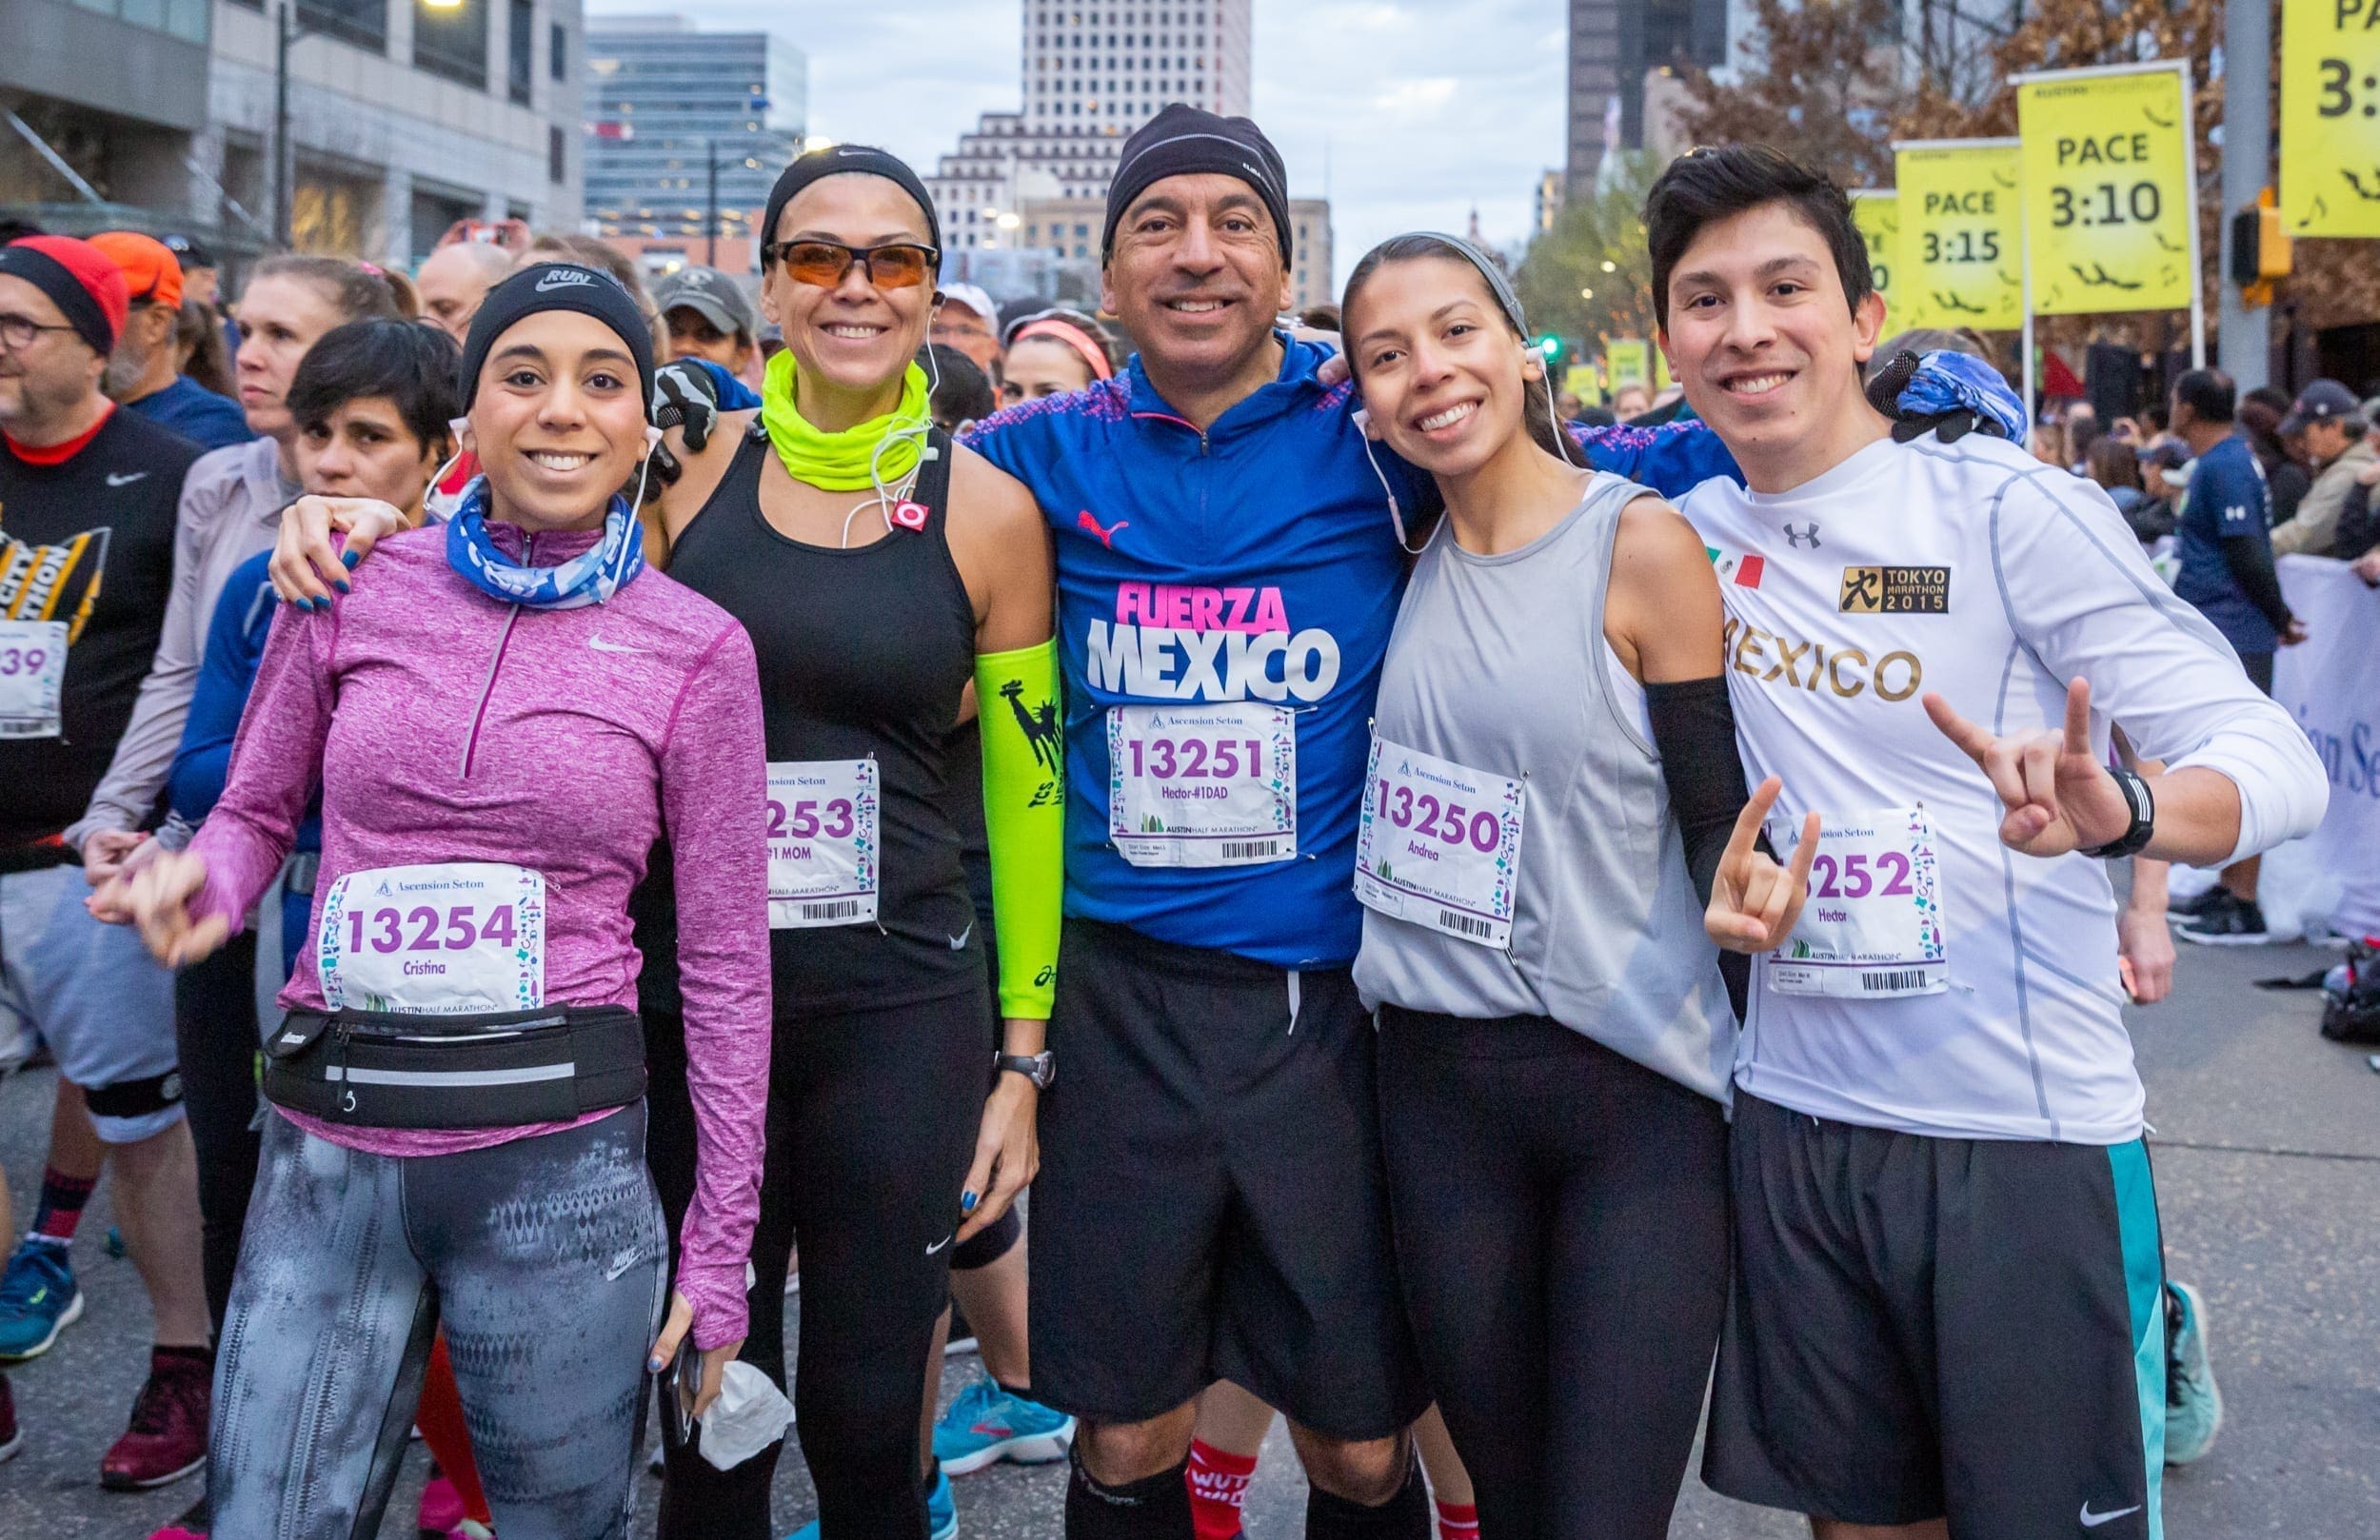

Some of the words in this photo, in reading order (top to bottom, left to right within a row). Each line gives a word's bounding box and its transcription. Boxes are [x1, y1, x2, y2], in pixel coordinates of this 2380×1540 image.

[2057, 133, 2149, 167] PACE
[1925, 190, 1995, 214] PACE
[2052, 180, 2160, 227] 3:10
[1923, 230, 2000, 264] 3:15
[545, 269, 591, 284] RUN
[1887, 569, 1945, 584] TOKYO
[1887, 584, 1944, 595] MARATHON
[1116, 581, 1291, 635] FUERZA
[1886, 596, 1943, 610] 2015
[1087, 618, 1340, 702] MEXICO
[1167, 717, 1214, 726] Ascension
[1216, 717, 1243, 725] Seton
[1129, 739, 1261, 780] 13251
[797, 777, 826, 785] Seton
[1413, 767, 1452, 788] Ascension
[1453, 779, 1477, 794] Seton
[1162, 786, 1228, 800] Hector-#1DAD
[1379, 779, 1500, 853] 13250
[1844, 827, 1874, 838] Seton
[782, 845, 812, 860] MOM
[1408, 840, 1438, 861] Andrea
[1806, 852, 1914, 898] 252
[396, 879, 449, 892] Ascension
[452, 879, 484, 890] Seton
[1818, 908, 1847, 922] Hector
[348, 905, 517, 953] 13254
[404, 960, 446, 976] Cristina
